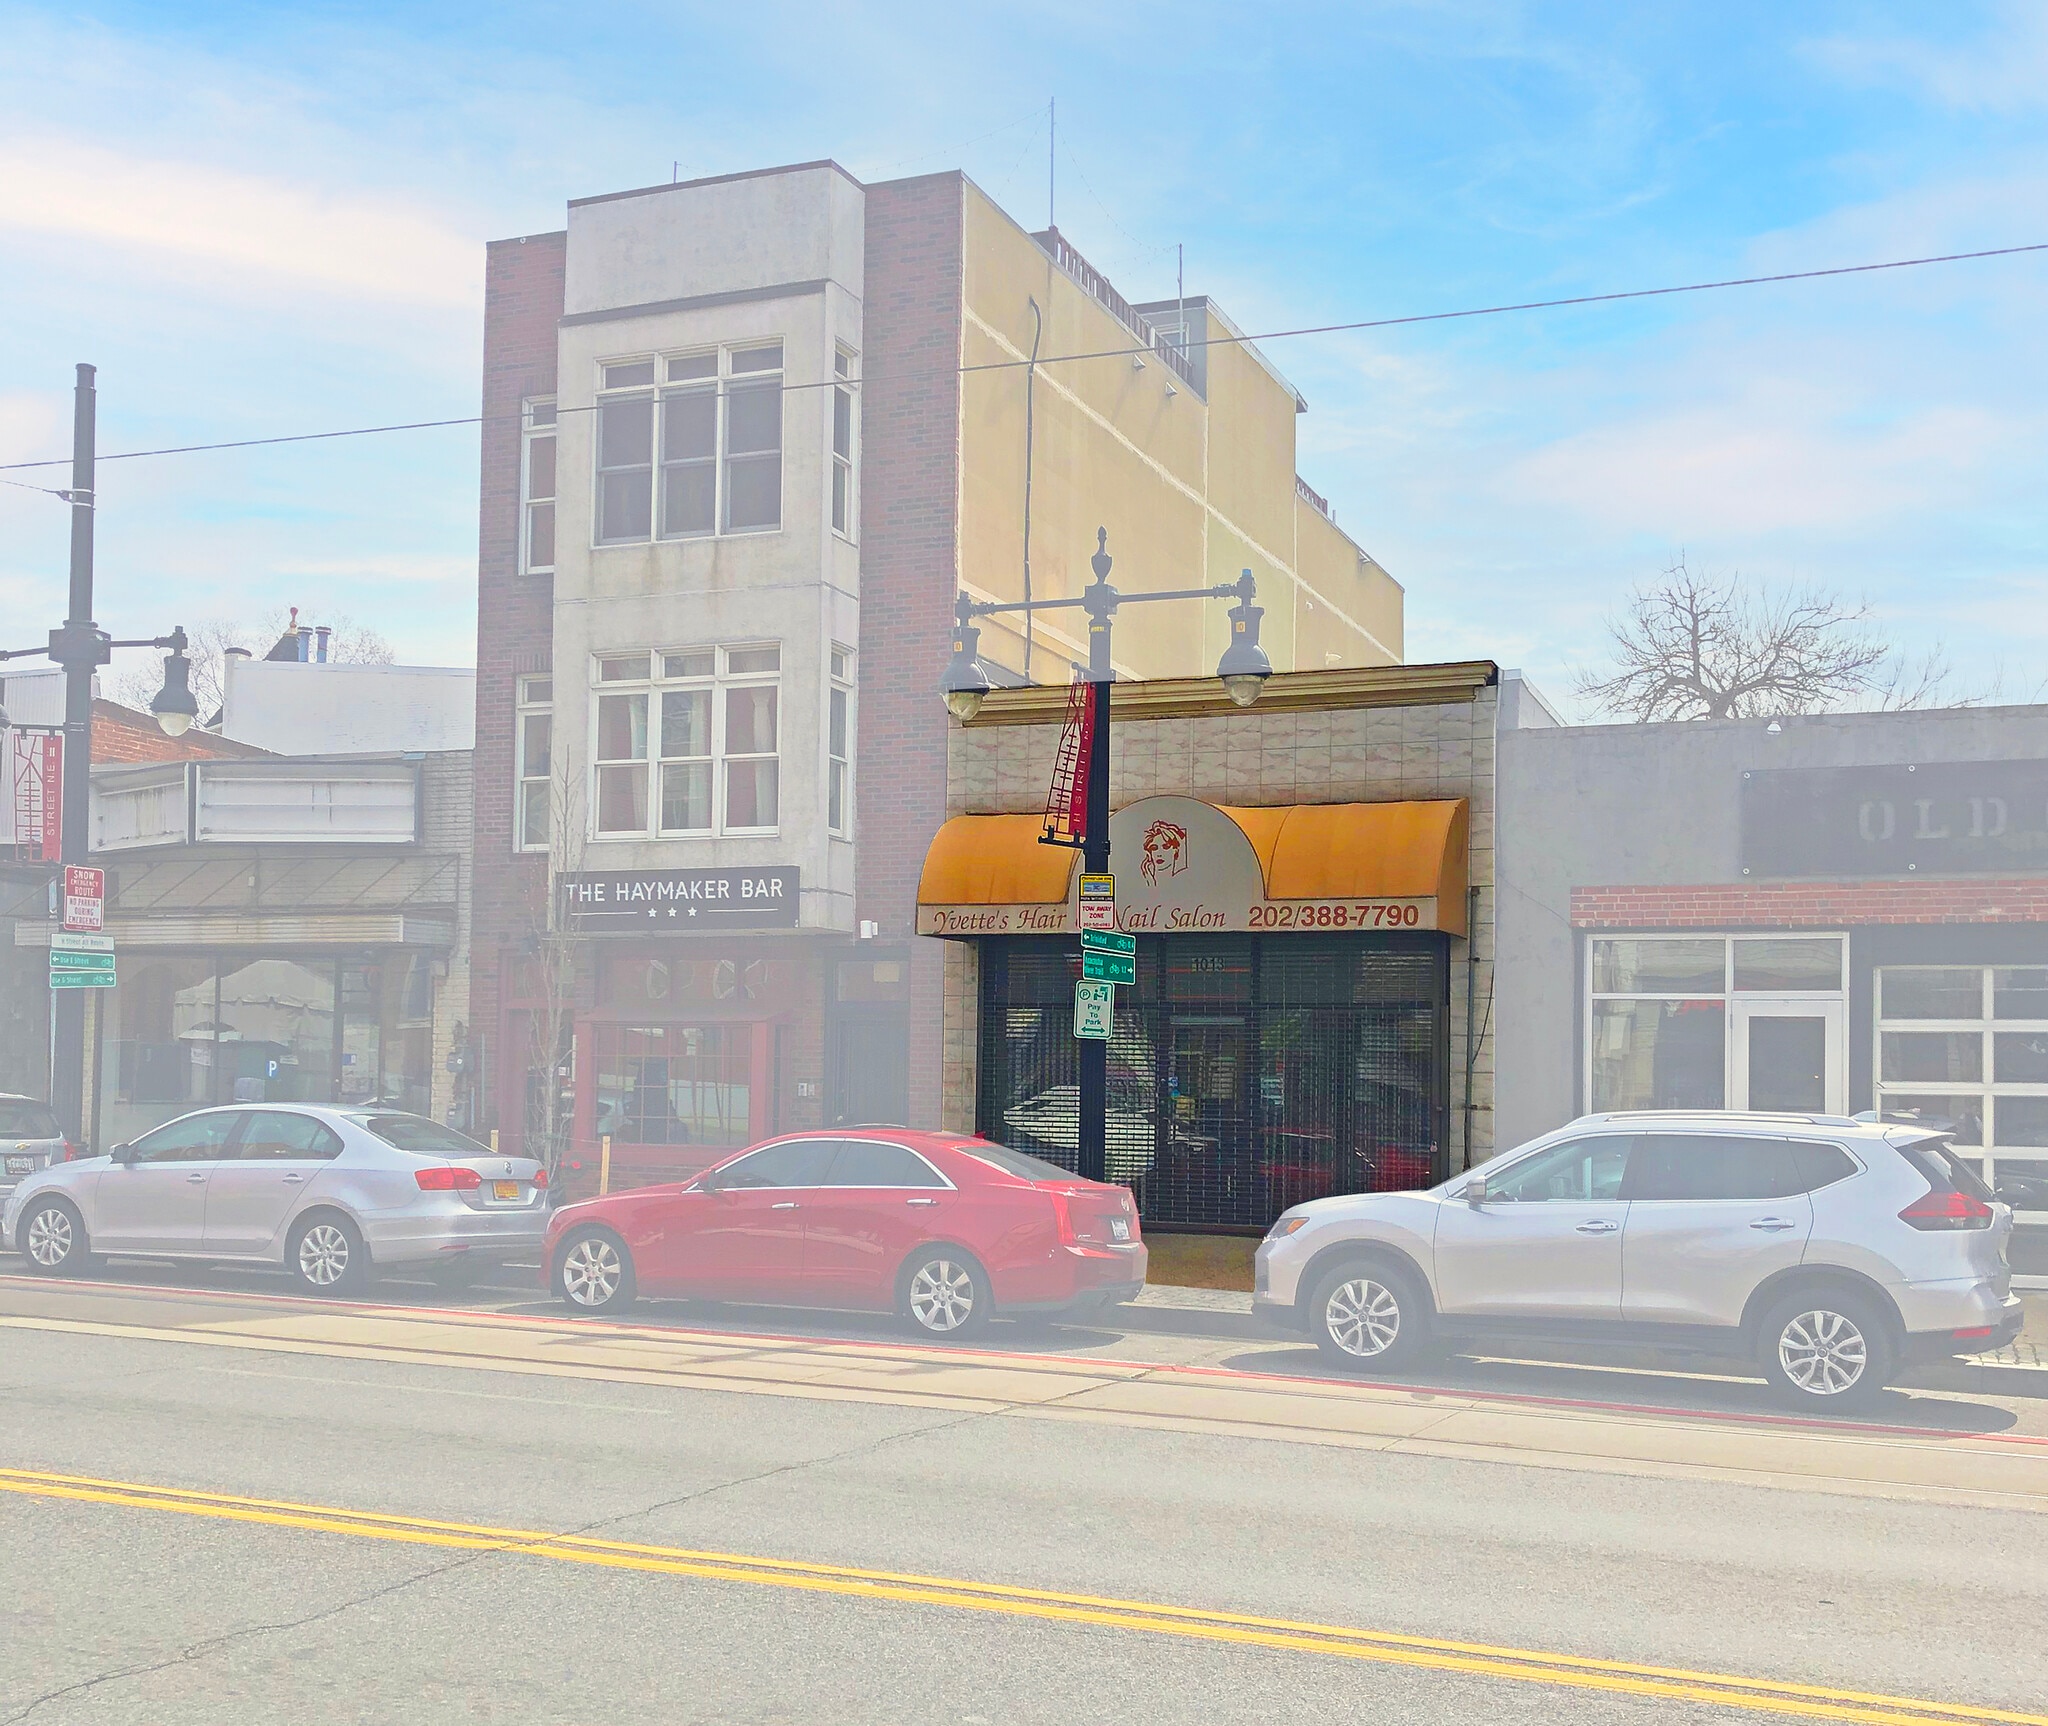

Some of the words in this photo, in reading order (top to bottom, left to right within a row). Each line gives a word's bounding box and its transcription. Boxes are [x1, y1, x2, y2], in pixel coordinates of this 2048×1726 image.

[46, 789, 56, 836] STREET
[1858, 797, 2008, 841] OLD
[73, 870, 94, 880] SNOW
[70, 878, 99, 888] EMERGENCY
[74, 886, 95, 897] ROUTE
[565, 883, 606, 902] THE
[616, 880, 730, 901] HAYMAKER
[741, 878, 783, 898] BAR
[69, 897, 77, 906] NO
[77, 898, 100, 908] PARKING
[74, 906, 94, 916] DURING
[69, 916, 99, 925] EMERGENCY
[934, 909, 1009, 932] Yvette's
[1017, 906, 1067, 929] Hair
[1165, 904, 1226, 930] Salon
[1248, 904, 1419, 928] 202/388-7790
[1087, 1003, 1100, 1011] Pay
[1085, 1018, 1102, 1026] Park
[268, 1060, 277, 1077] P
